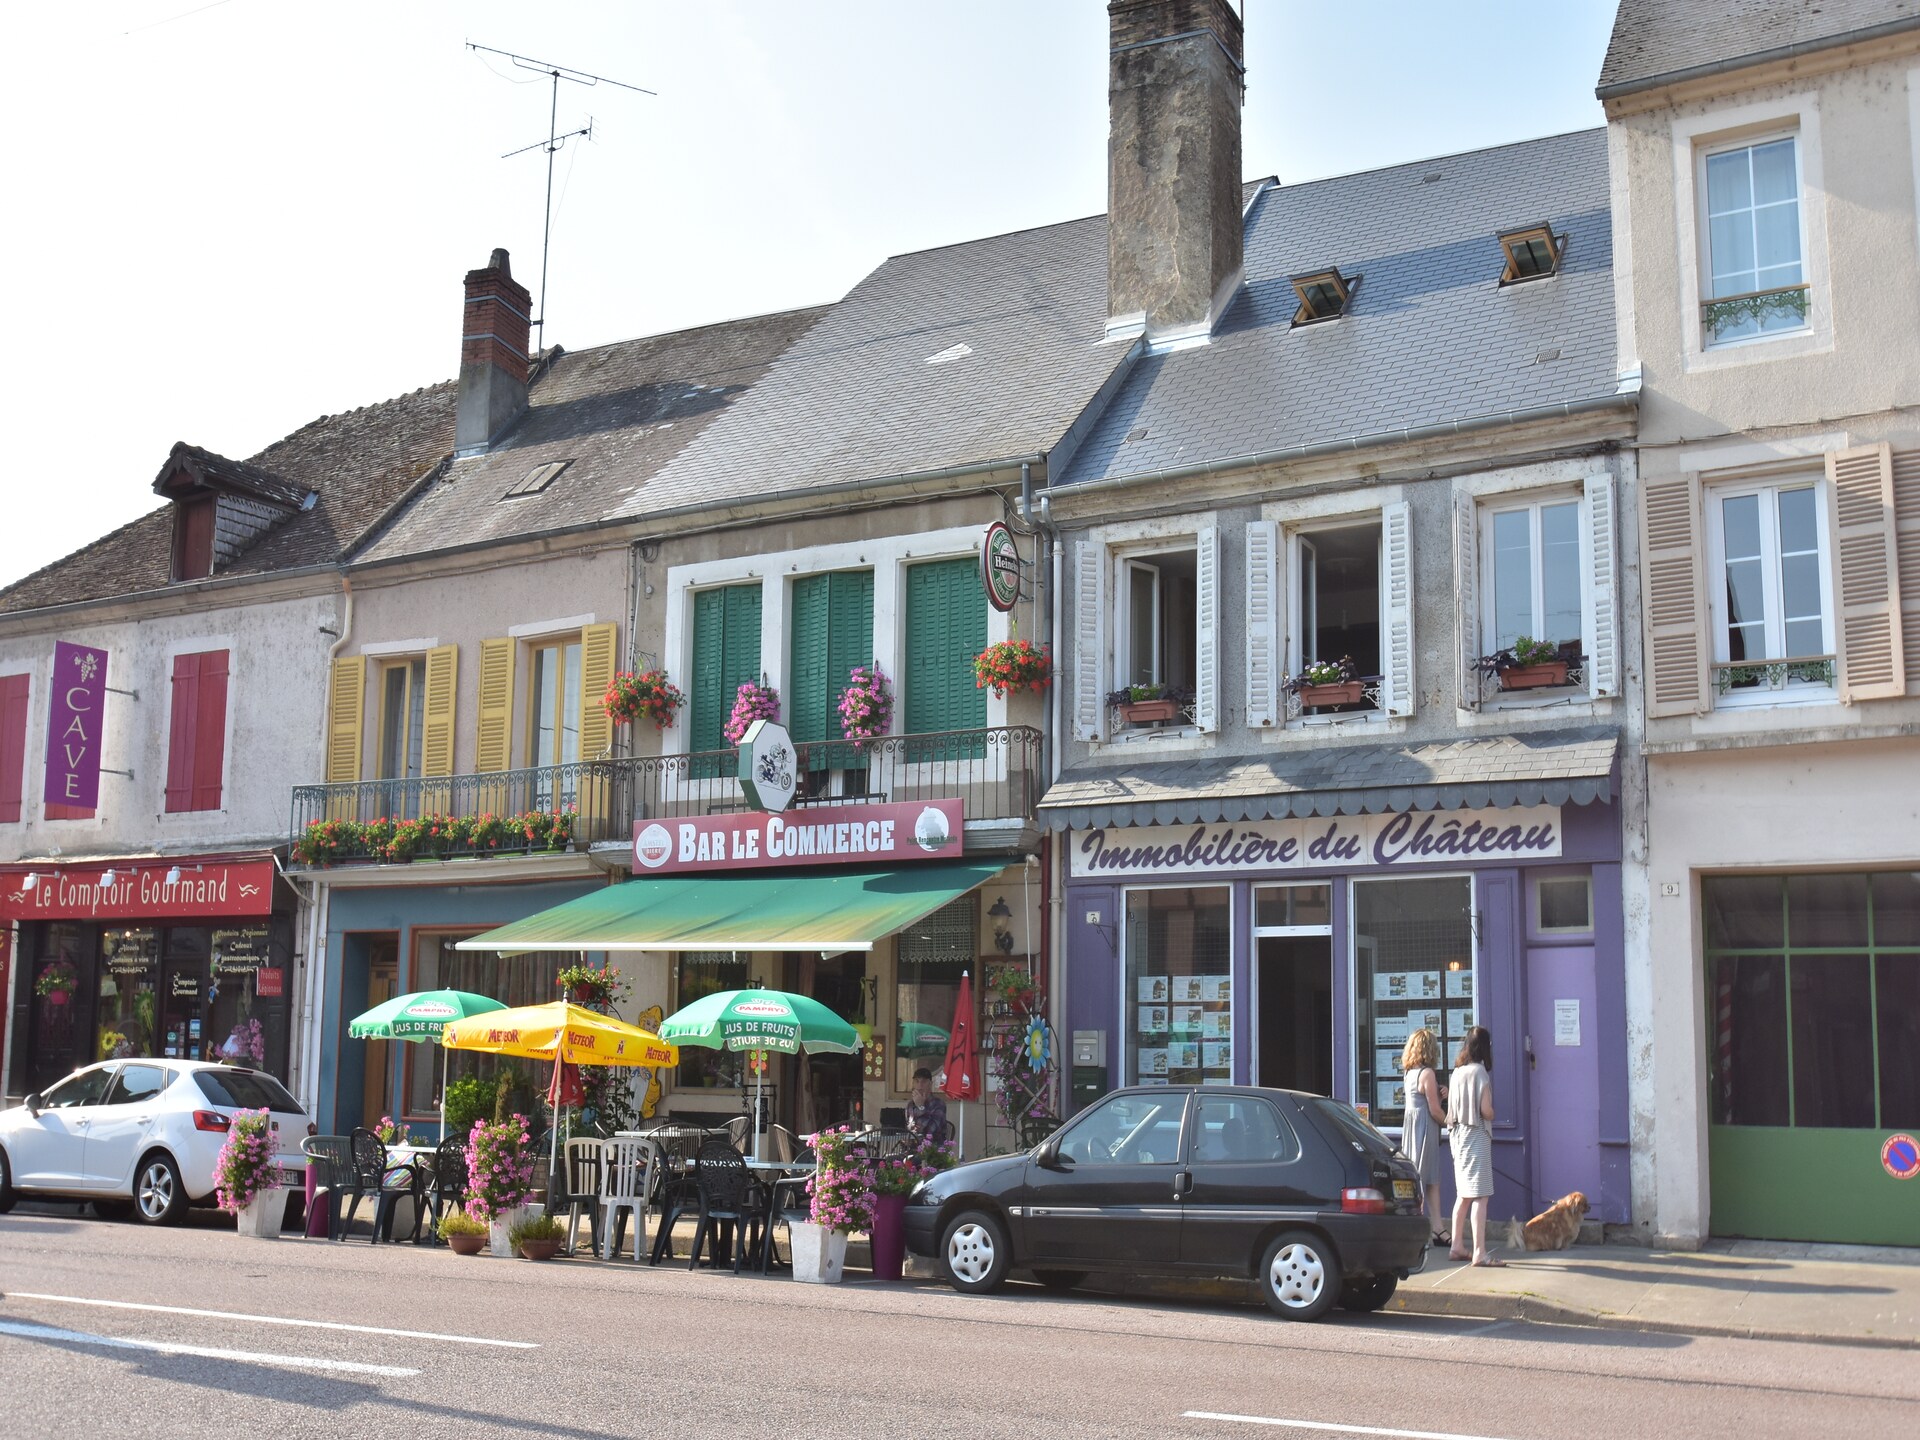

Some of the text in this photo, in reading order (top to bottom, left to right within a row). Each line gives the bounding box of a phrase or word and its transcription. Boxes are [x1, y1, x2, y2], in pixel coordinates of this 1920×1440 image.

[63, 687, 91, 798] CAVE
[678, 817, 895, 862] BAR LE COMMERCE
[1081, 811, 1556, 871] Immobilière du Château
[35, 869, 228, 915] Le Comptoir Gourmand
[1667, 884, 1673, 894] 9
[395, 1022, 411, 1033] JUS
[414, 1022, 426, 1032] DE
[725, 1022, 795, 1037] JUS DE FRUITS
